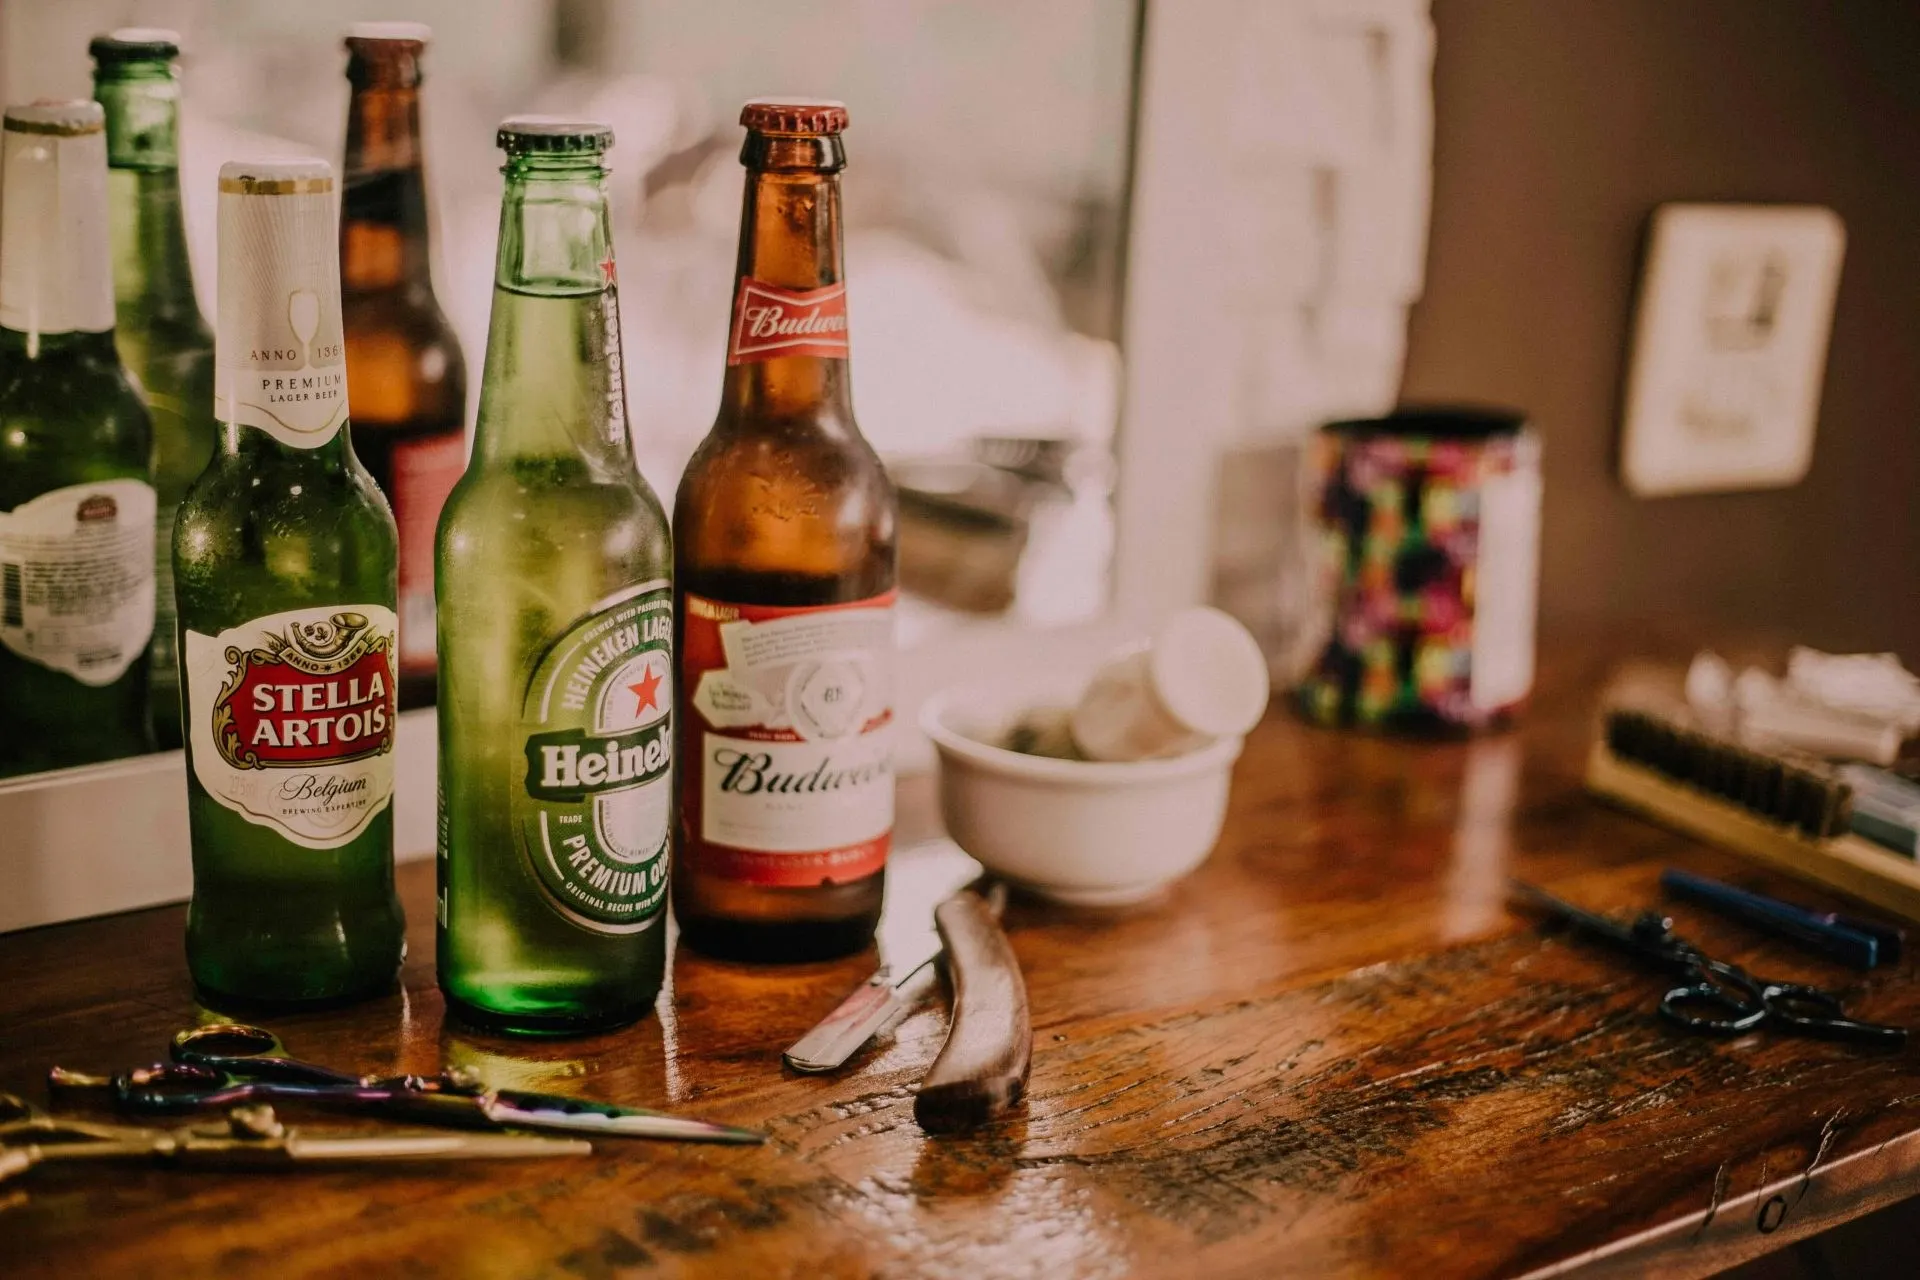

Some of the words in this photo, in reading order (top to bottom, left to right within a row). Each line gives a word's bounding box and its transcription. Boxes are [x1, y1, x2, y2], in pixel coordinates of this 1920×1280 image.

[251, 350, 297, 361] ANNO
[262, 374, 341, 390] PREMIUM
[270, 393, 309, 403] LAGER
[315, 389, 337, 400] BEER
[616, 607, 636, 623] WITH
[286, 652, 319, 671] ANNO
[561, 623, 640, 709] HEINEKEN
[252, 671, 385, 713] STELLA
[251, 703, 386, 747] ARTOIS
[279, 774, 367, 806] Belgium
[325, 799, 366, 812] EXPERTISE
[560, 815, 582, 824] TRADE
[562, 834, 646, 896] PREMIUM
[565, 881, 604, 909] ORIGINAL
[606, 902, 633, 912] RECIPE
